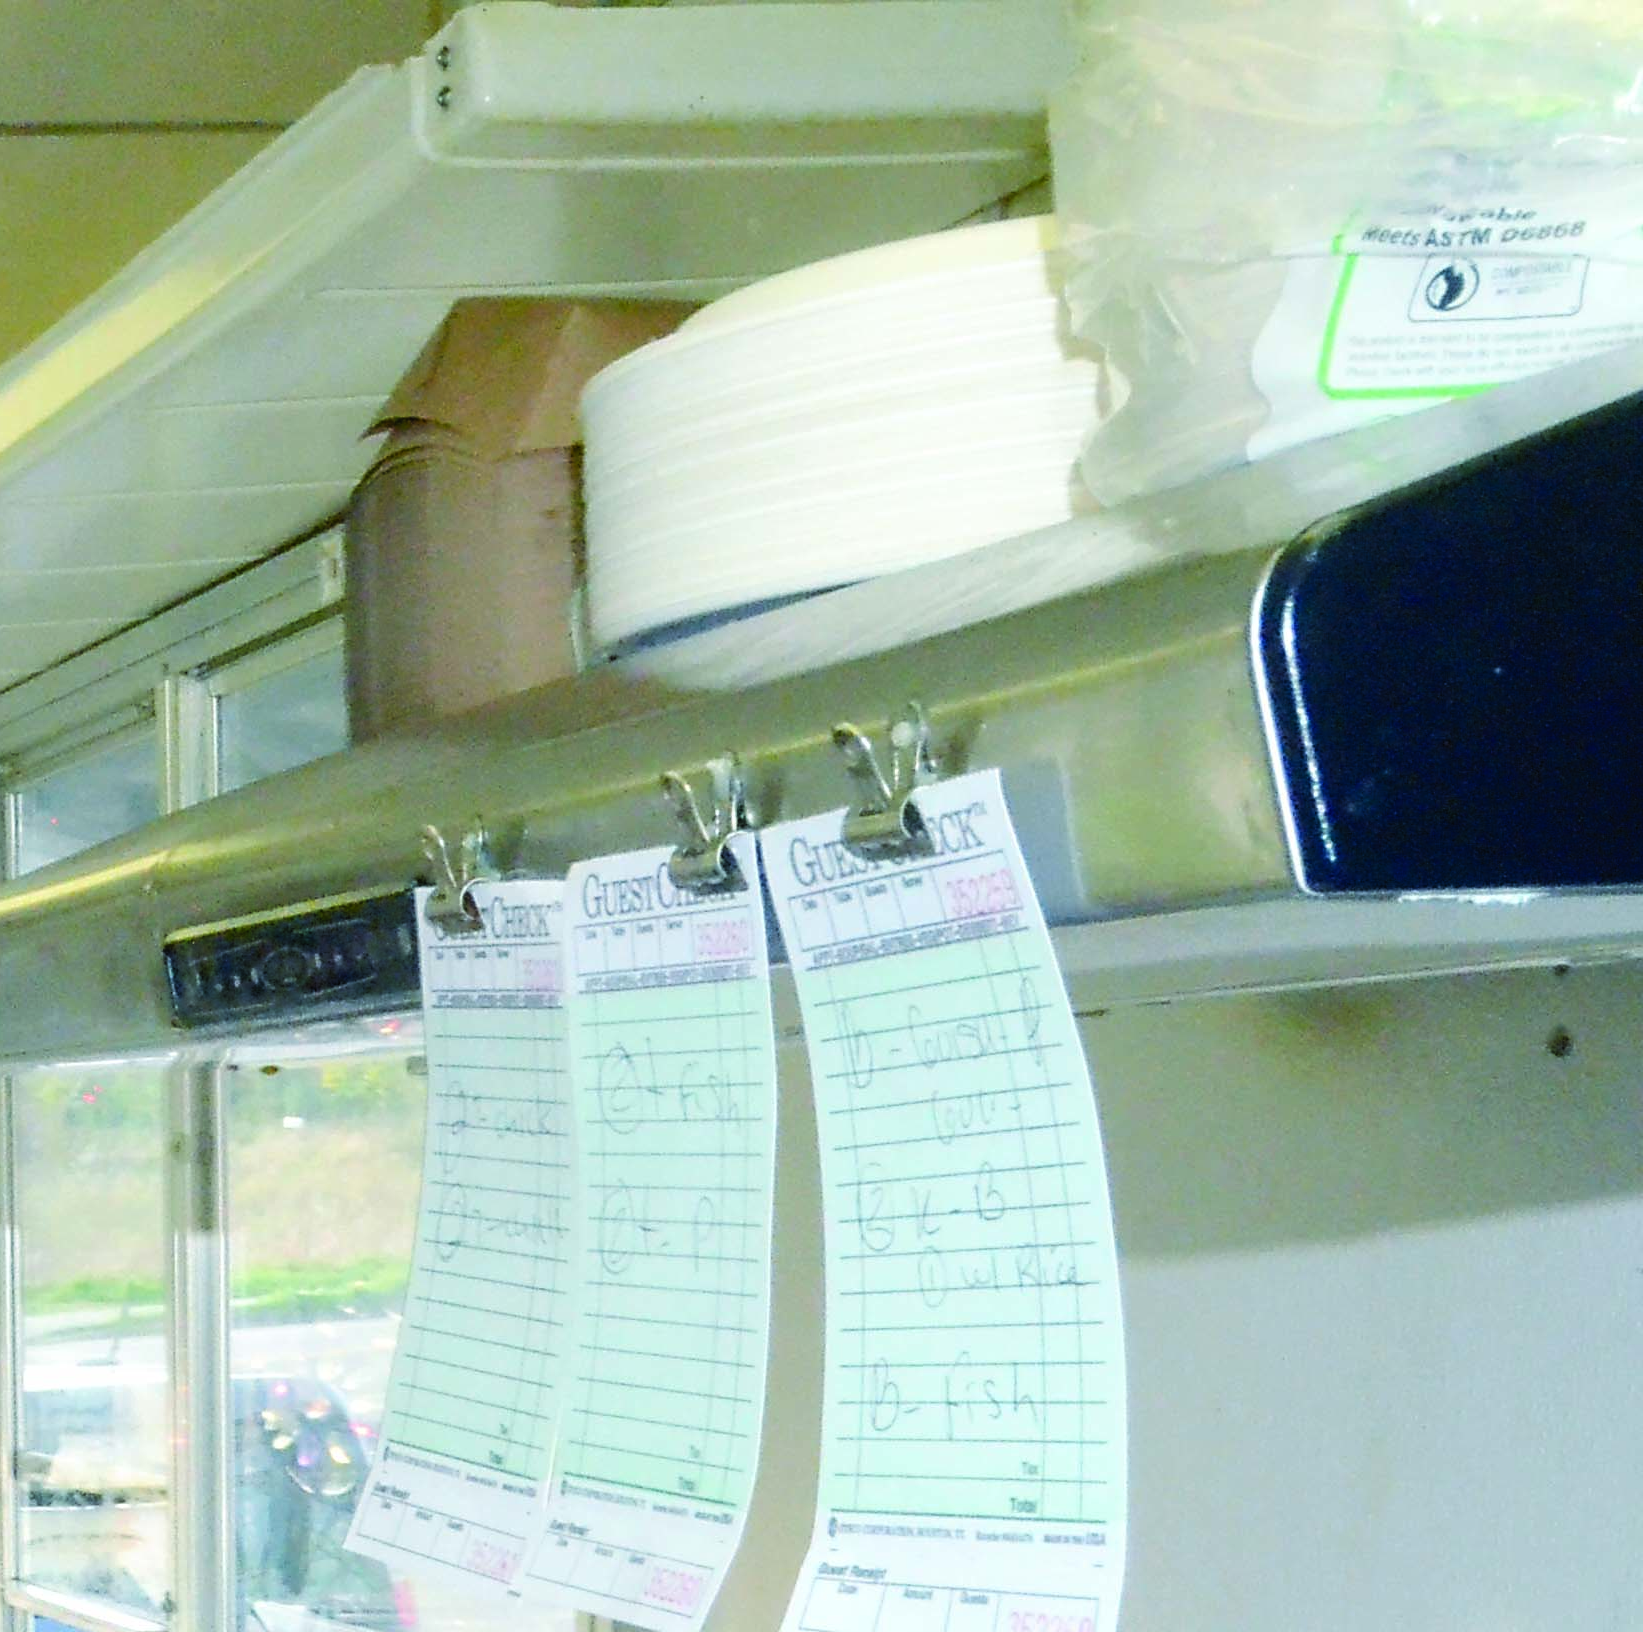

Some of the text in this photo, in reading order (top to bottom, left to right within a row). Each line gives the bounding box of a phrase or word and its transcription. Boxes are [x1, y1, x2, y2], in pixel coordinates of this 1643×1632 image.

[1361, 221, 1586, 248] Meets ASTM D6868
[583, 873, 655, 919] GUEST
[1009, 1497, 1037, 1514] Total
